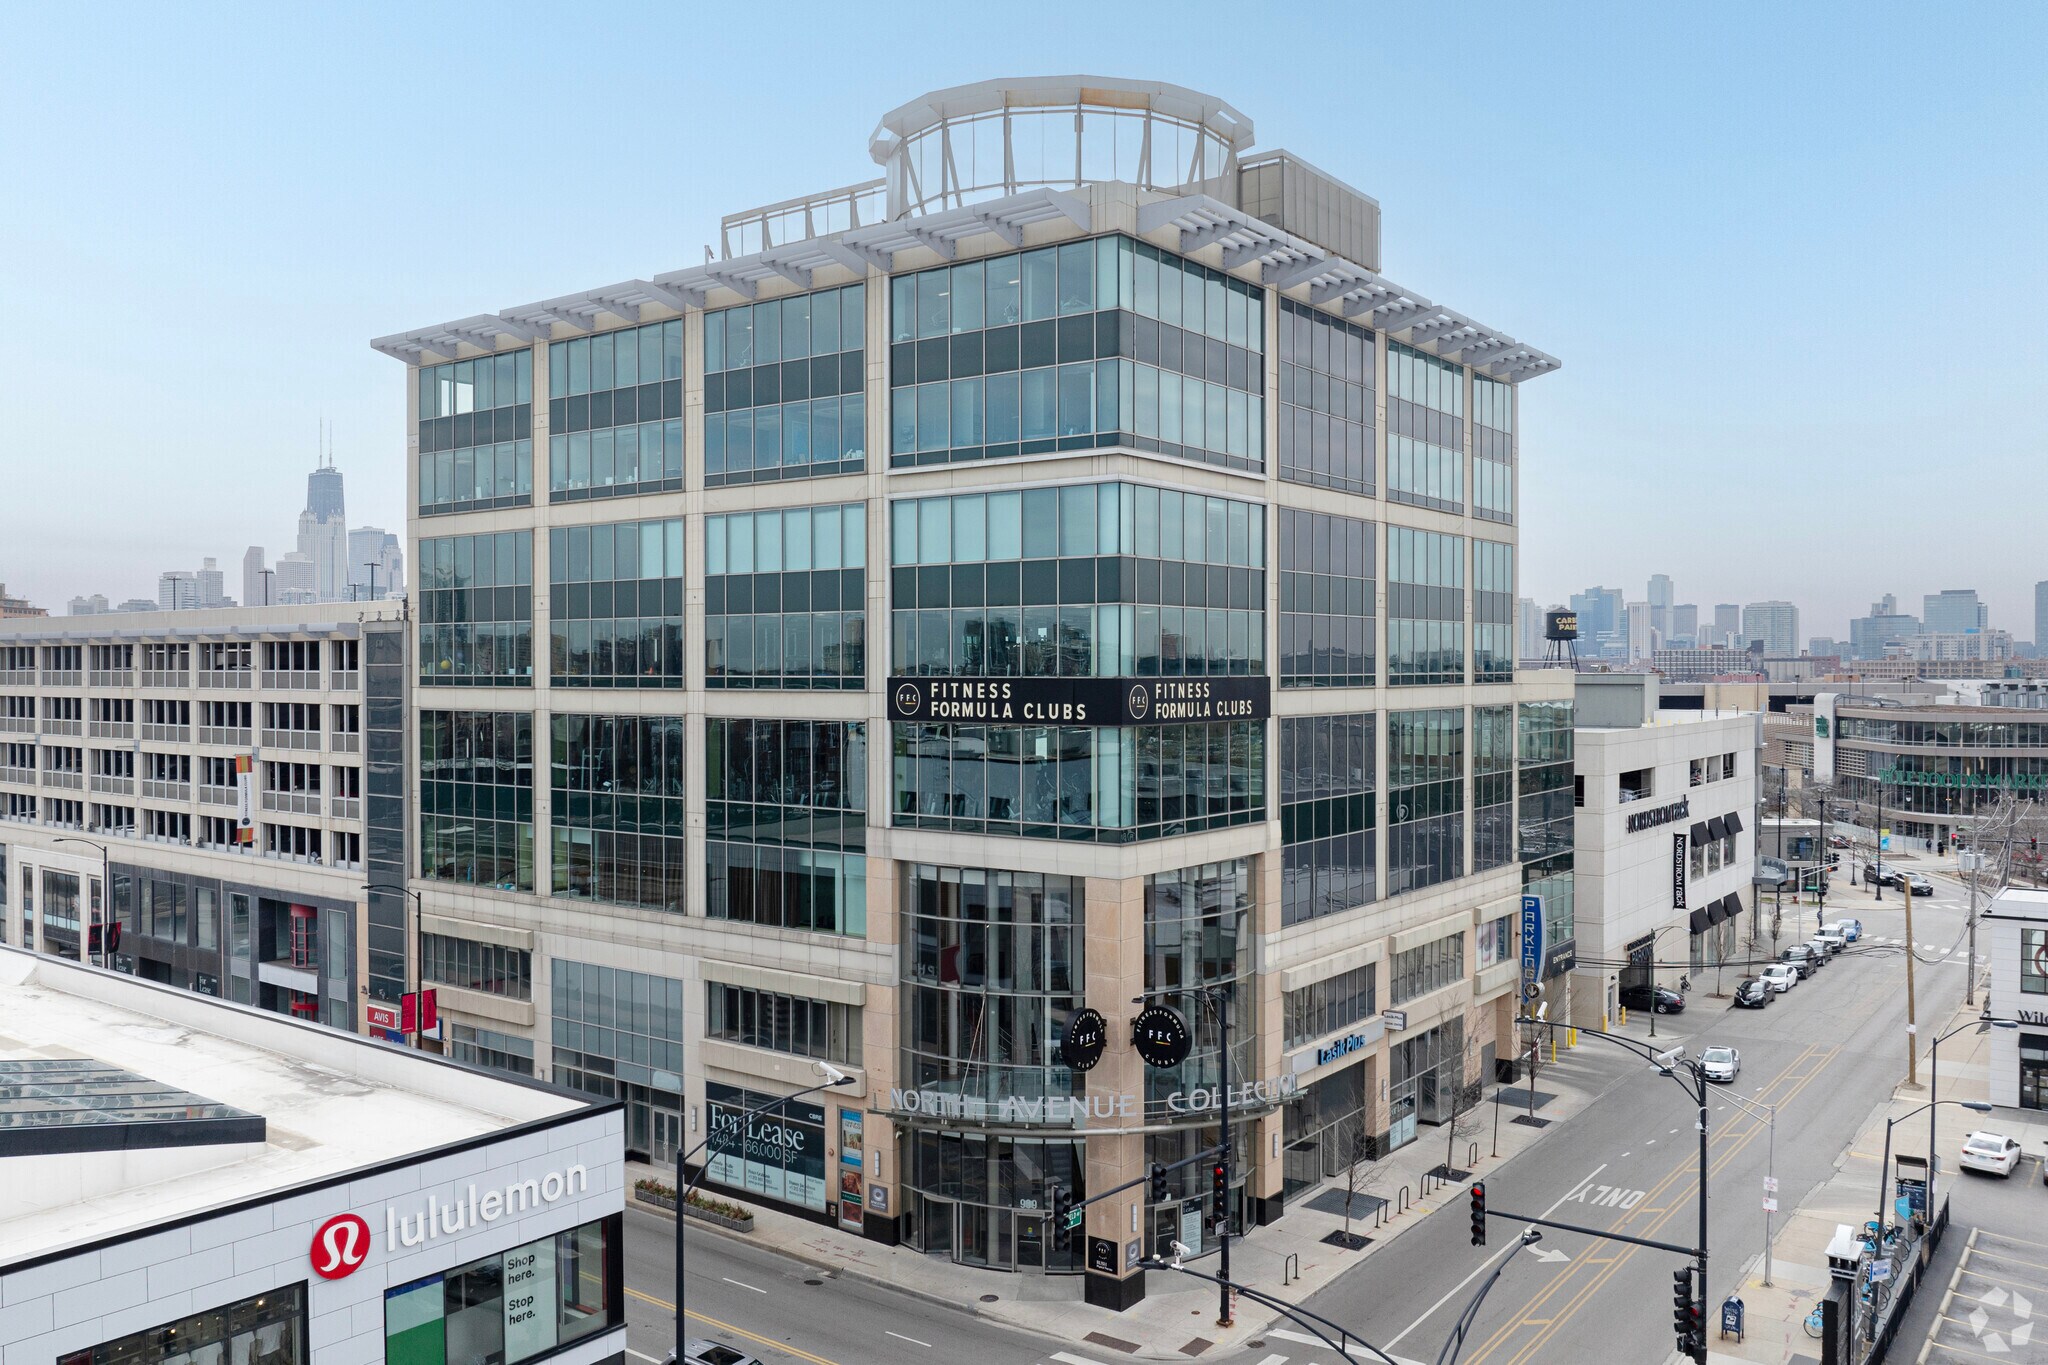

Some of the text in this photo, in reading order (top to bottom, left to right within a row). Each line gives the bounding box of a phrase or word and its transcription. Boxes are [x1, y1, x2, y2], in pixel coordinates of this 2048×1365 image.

[931, 682, 1012, 699] FITNESS
[1156, 682, 1210, 699] FITNESS
[931, 702, 1087, 720] FORMULA CLUBS
[1156, 699, 1253, 719] FORMULA CLUBS
[1918, 772, 1981, 789] FOODS
[1675, 836, 1684, 908] NORDSTROM rack
[1525, 900, 1535, 979] PARKING
[1553, 949, 1573, 964] ENTRANCE
[374, 1011, 389, 1023] AVIS
[1136, 1010, 1184, 1039] FITNESS FORMULA
[1080, 1032, 1096, 1045] FFC
[1148, 1029, 1171, 1042] FFC
[1145, 1053, 1175, 1065] CLUBS
[890, 1087, 968, 1117] NORTH
[1000, 1094, 1138, 1119] AVENUE
[710, 1104, 805, 1150] For Lease
[784, 1149, 798, 1163] SF
[1020, 1198, 1037, 1209] 909
[1567, 1183, 1646, 1210] ONLY
[387, 1163, 587, 1252] lululemon
[508, 1252, 535, 1271] Shop
[508, 1267, 535, 1285] here.
[508, 1294, 534, 1311] Stop
[509, 1308, 536, 1325] here.
